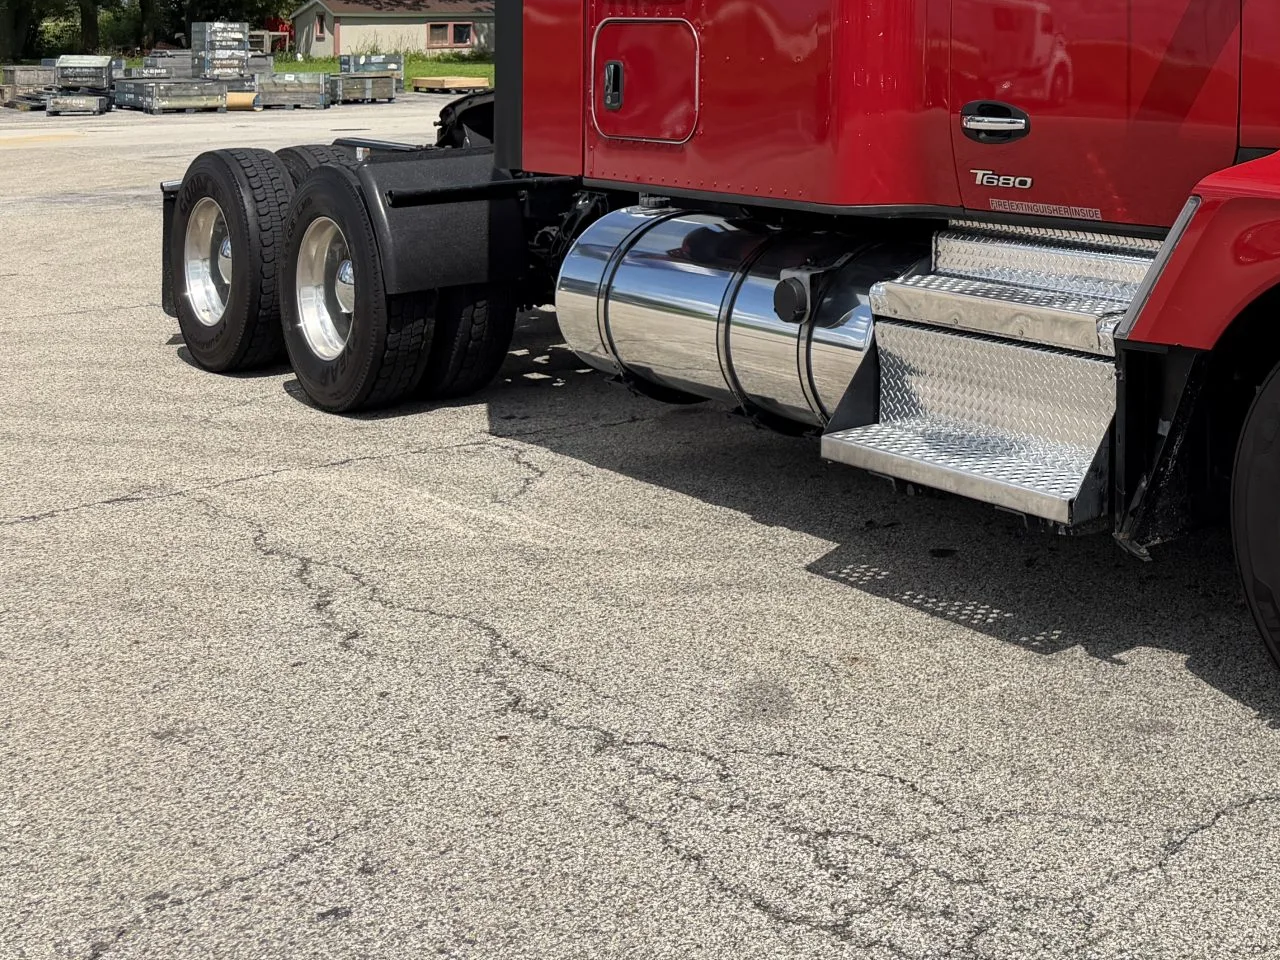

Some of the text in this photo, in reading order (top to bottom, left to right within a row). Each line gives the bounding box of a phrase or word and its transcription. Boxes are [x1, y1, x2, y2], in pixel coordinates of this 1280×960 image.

[970, 169, 1033, 189] T680
[991, 200, 1101, 219] FIRE EXTINGUISHER INSIDE
